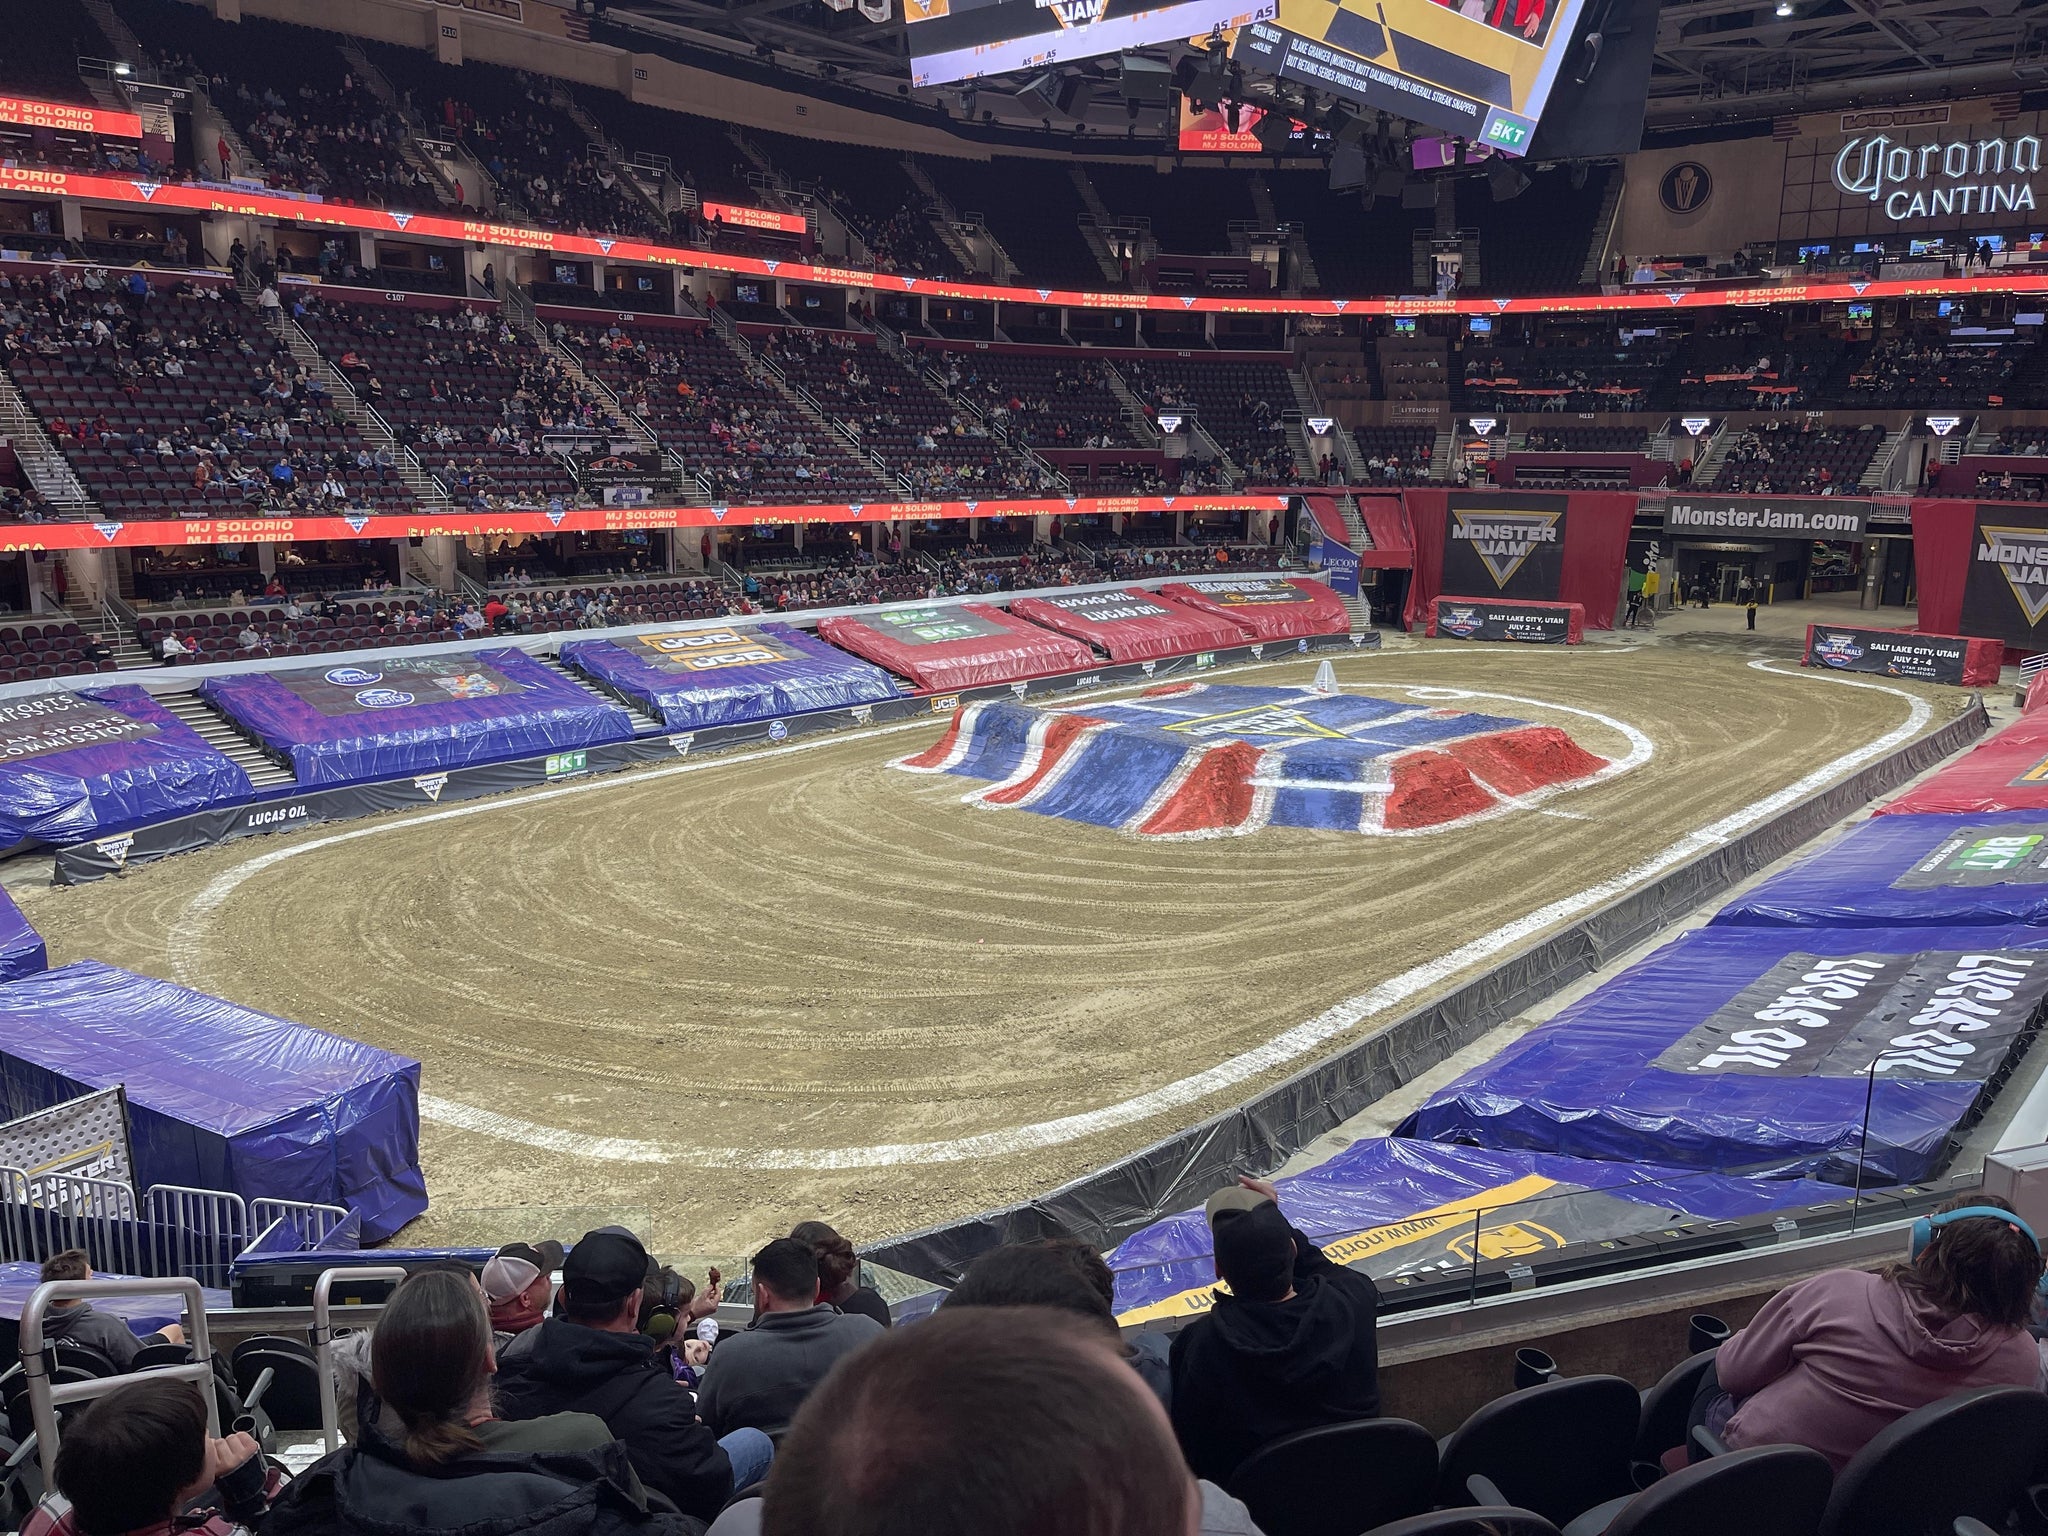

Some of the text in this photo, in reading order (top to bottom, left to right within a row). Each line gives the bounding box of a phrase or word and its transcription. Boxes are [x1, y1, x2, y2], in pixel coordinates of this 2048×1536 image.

[1060, 0, 1102, 22] JAM
[1230, 12, 1252, 28] BIG
[1254, 5, 1273, 21] AS
[1264, 28, 1282, 45] WEST
[1022, 57, 1032, 66] AS
[1046, 49, 1057, 59] AS
[1286, 54, 1367, 93] BUT RETAINS SERIES POINTS LEAD.
[1291, 38, 1309, 55] BLAKE
[1307, 44, 1331, 63] GRANGER
[1329, 53, 1356, 70] (MONSTER
[1355, 63, 1371, 76] MUTT
[1398, 79, 1410, 92] HAS
[1409, 83, 1432, 100] OVERALL
[1431, 91, 1453, 107] STREAK
[1451, 97, 1477, 117] SNAPPED,
[172, 91, 185, 99] 209
[0, 101, 93, 120] MJ SOLORIO
[23, 114, 94, 132] SOLORIO
[1203, 133, 1217, 141] MJ
[1489, 121, 1526, 143] BKT
[1202, 141, 1217, 149] MJ
[1831, 133, 2042, 201] Corona
[1885, 182, 2036, 221] CANTINA
[730, 208, 781, 221] MJ SOLORIO
[730, 216, 781, 230] MJ SOLORIO
[464, 221, 553, 243] MJ SOLORIO
[813, 266, 874, 281] MJ SOLORIO
[1891, 264, 1934, 279] Sprite
[385, 293, 405, 302] C 107
[1082, 293, 1148, 303] MJ SOLORIO
[1726, 286, 1807, 298] MJ SOLORIO
[1404, 300, 1456, 308] SOLORIO
[606, 510, 677, 521] MJ SOLORIO
[891, 504, 942, 513] MJ SOLORIO
[1671, 505, 1859, 532] MonsterJam.com
[185, 520, 294, 533] MJ SOLORIO
[1452, 524, 1556, 543] MONSTER
[1479, 541, 1529, 557] JAM
[1323, 557, 1358, 568] LECOM
[1082, 604, 1167, 621] LUCAS OIL
[1488, 613, 1564, 625] SALT LAKE CITY, UTAH
[1464, 618, 1482, 627] FINALS
[1508, 623, 1525, 631] JULY
[914, 624, 973, 639] BKT
[1840, 646, 1862, 657] FINALS
[1870, 642, 1960, 659] SALT LAKE CITY, UTAH
[692, 650, 775, 668] JCB
[1196, 653, 1215, 666] BKT
[1892, 655, 1933, 667] JULY 2 4
[1076, 675, 1100, 686] LUCAS OIL
[1901, 669, 1936, 678] COMMISSION
[934, 696, 959, 711] JCB
[43, 716, 126, 737] SPORTS
[1184, 708, 1310, 737] MONSTER
[1246, 717, 1303, 735] JAM
[546, 754, 586, 773] BKT
[414, 777, 449, 789] MONSTER
[425, 784, 441, 792] JAM
[248, 804, 308, 827] LUCAS OIL
[96, 838, 135, 853] MONSTER
[108, 847, 126, 857] JAM
[1963, 835, 2031, 871] BKT
[1697, 959, 1887, 1070] LUCAS OIL
[1862, 954, 2036, 1075] LUCAS OIL
